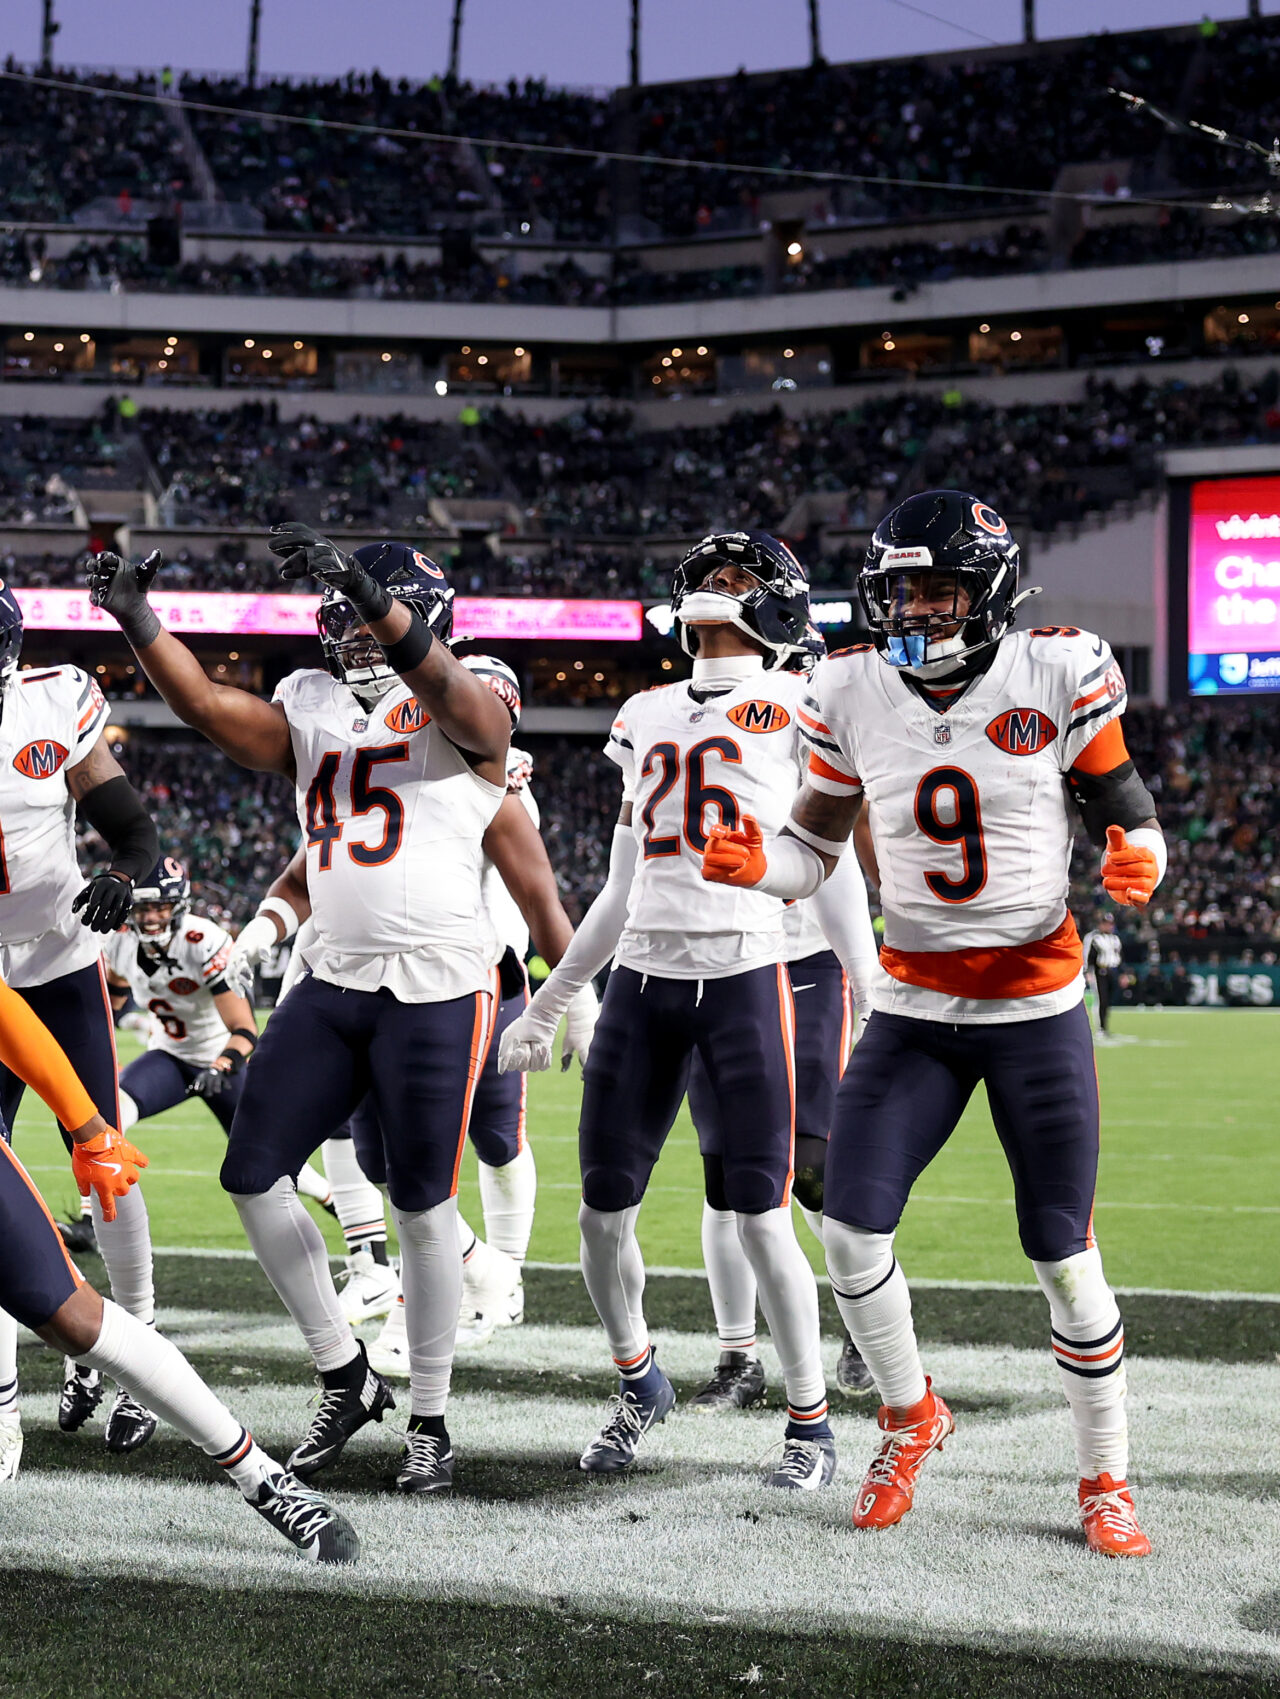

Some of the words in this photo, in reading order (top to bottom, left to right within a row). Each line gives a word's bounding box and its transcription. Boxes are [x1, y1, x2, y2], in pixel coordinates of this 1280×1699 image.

[1216, 592, 1277, 626] the
[306, 741, 410, 872] 45
[641, 736, 742, 860] 26
[914, 765, 988, 904] 9
[148, 999, 187, 1041] 6
[860, 1493, 877, 1516] 9
